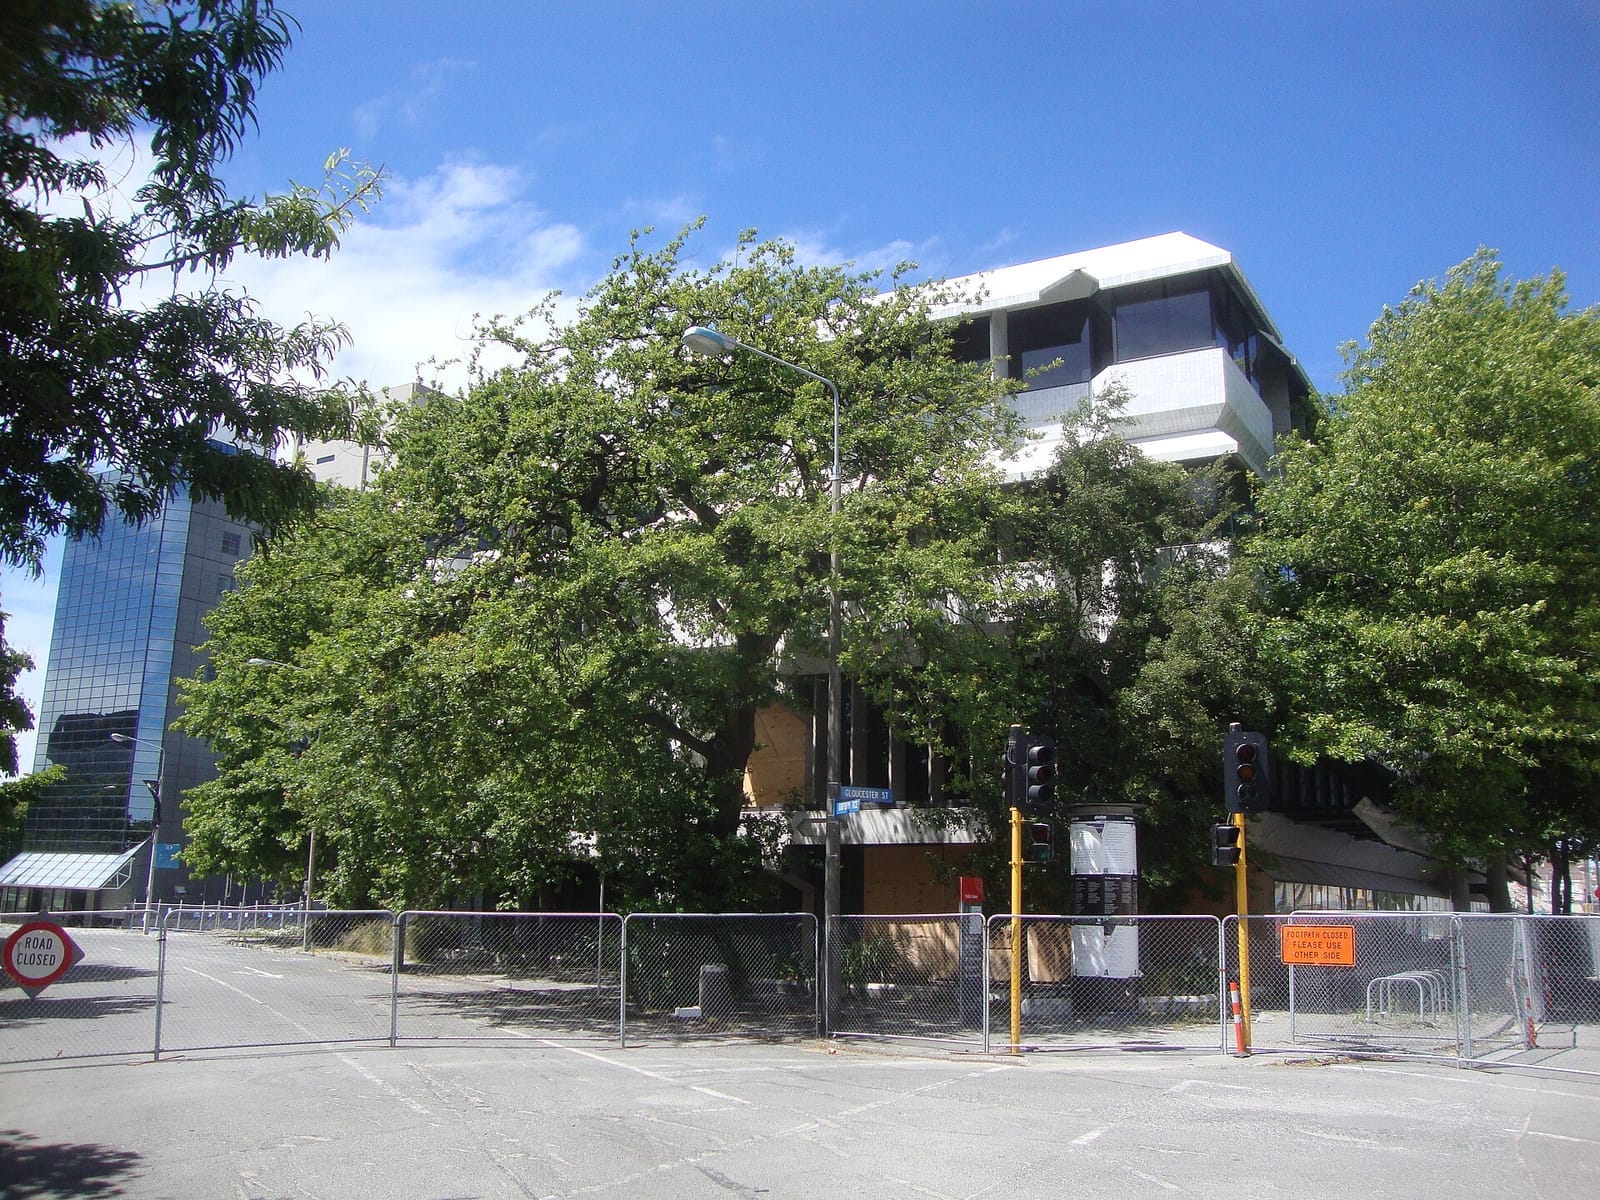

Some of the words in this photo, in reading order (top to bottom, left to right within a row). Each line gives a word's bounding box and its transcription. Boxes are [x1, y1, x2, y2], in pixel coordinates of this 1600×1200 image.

[844, 789, 879, 799] GLOUCESTER
[881, 791, 889, 800] ST
[1286, 930, 1320, 938] FOOTPATH
[1322, 930, 1349, 940] CLOSED
[25, 936, 53, 950] ROAD
[1292, 940, 1323, 949] PLEASE
[1326, 941, 1342, 950] USE
[17, 952, 56, 966] CLOSED
[1294, 951, 1319, 960] OTHER
[1323, 951, 1341, 960] SIDE
